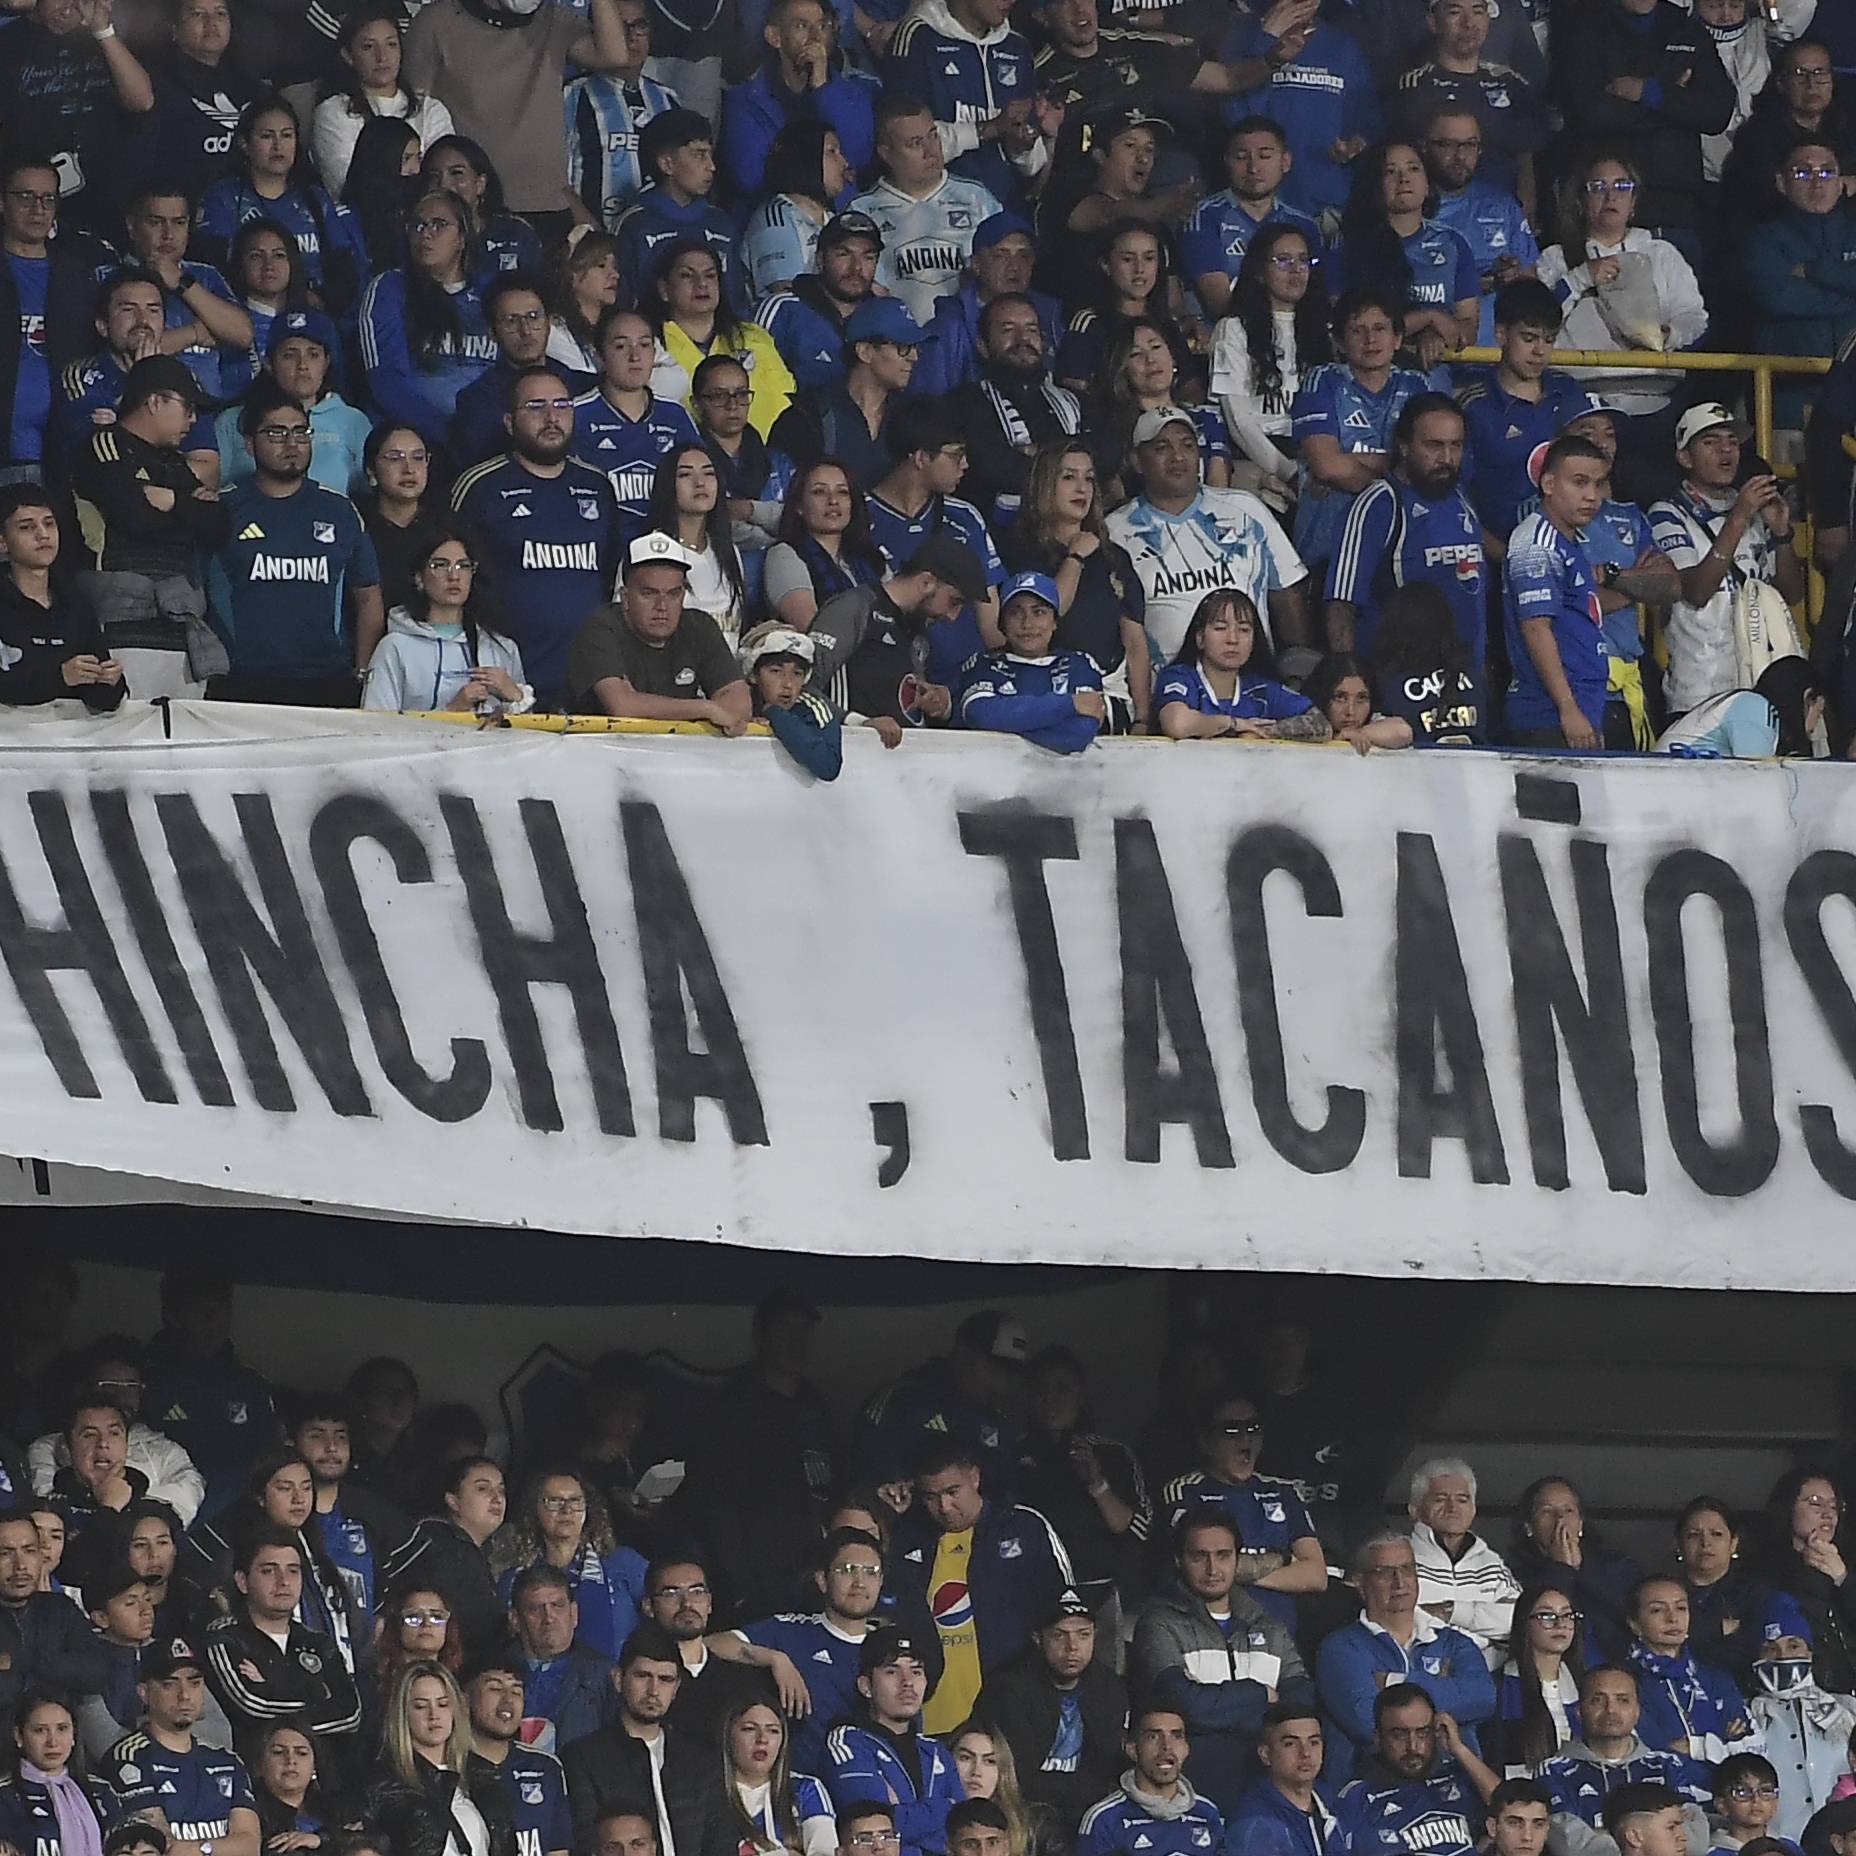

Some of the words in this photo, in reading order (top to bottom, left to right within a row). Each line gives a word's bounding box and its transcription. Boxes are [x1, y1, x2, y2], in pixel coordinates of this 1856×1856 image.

[895, 246, 964, 275] ANDINA
[249, 552, 329, 584] ANDINA
[522, 540, 599, 571] ANDINA
[1153, 566, 1236, 601] ANDINA
